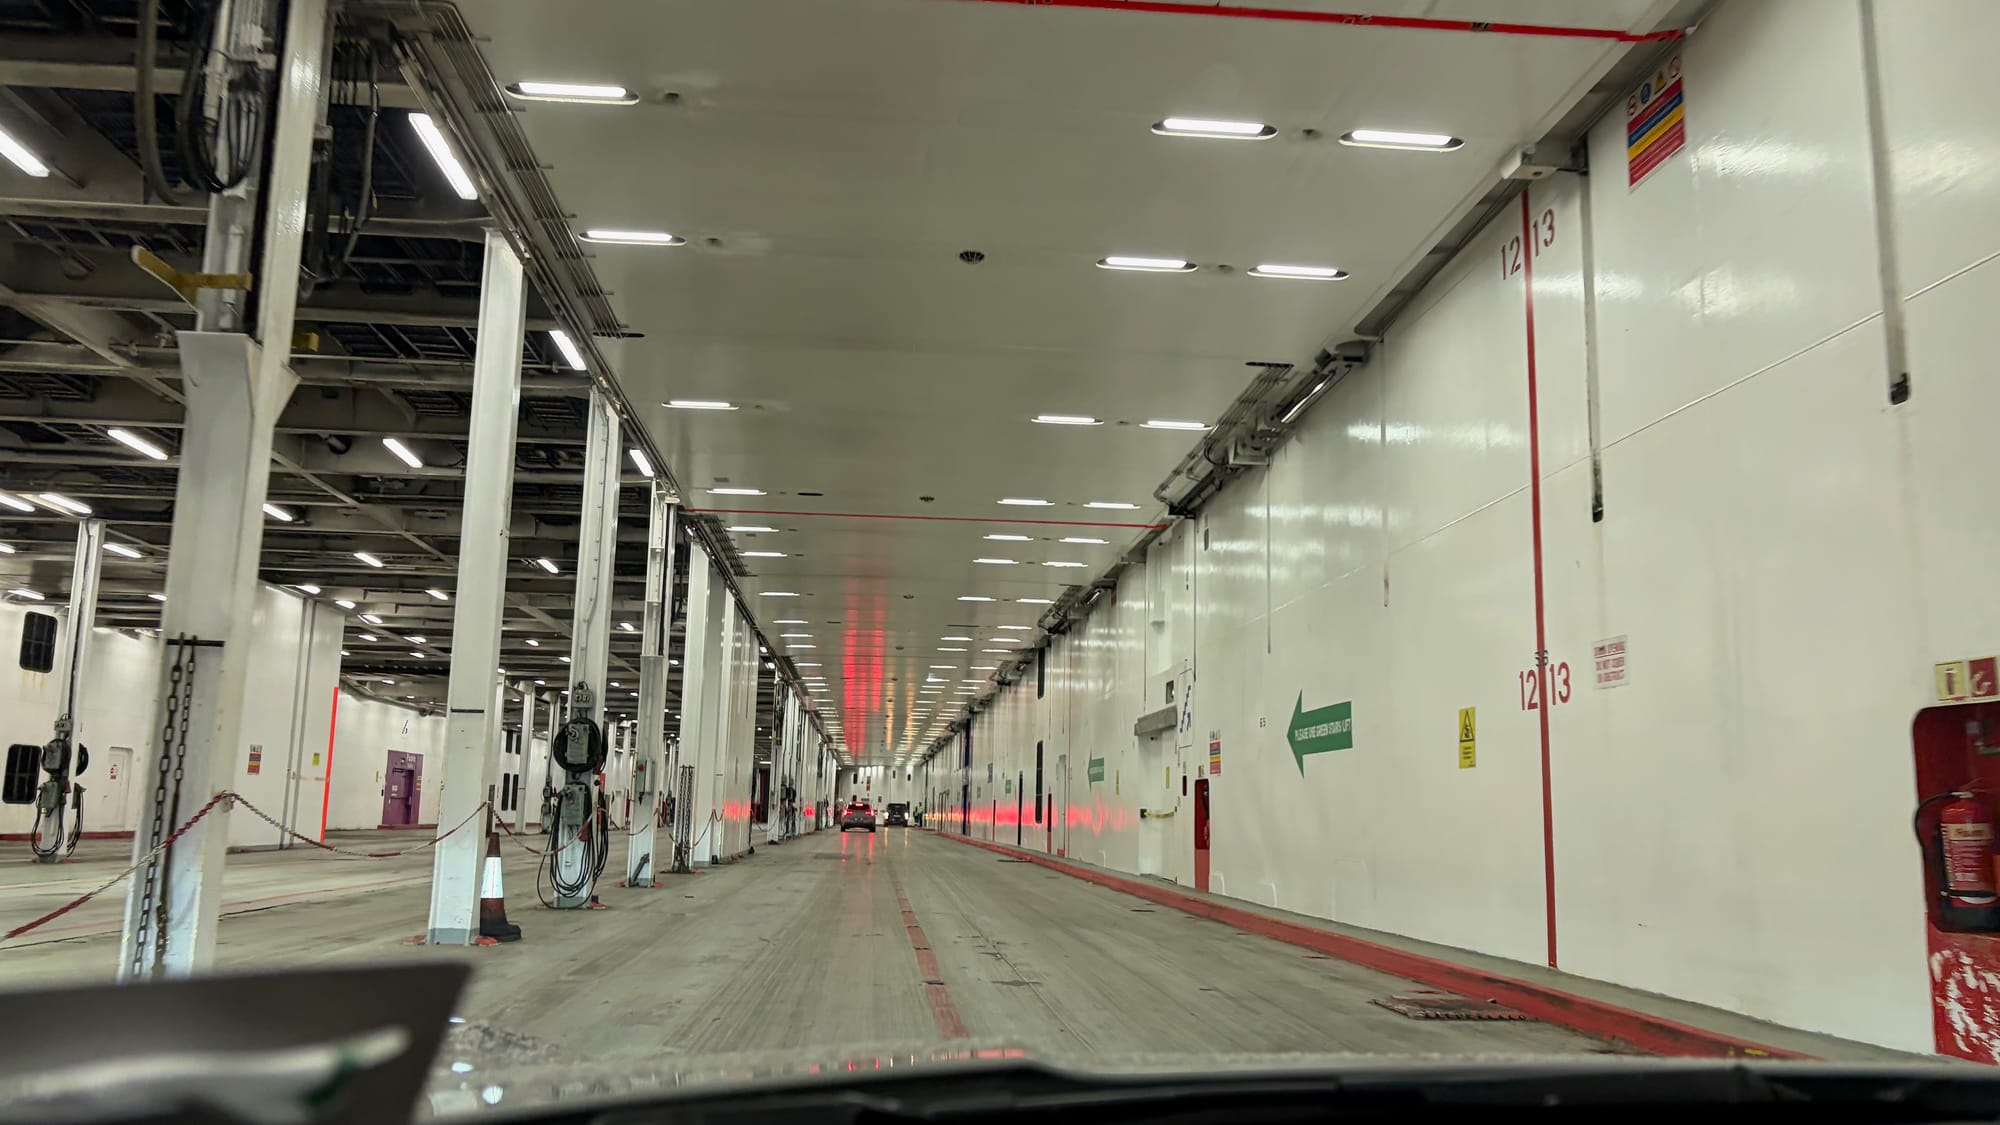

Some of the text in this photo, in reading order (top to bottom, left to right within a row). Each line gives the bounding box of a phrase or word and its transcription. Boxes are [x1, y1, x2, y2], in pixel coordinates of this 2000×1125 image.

[1532, 208, 1555, 257] 13
[1500, 235, 1521, 280] 12
[1519, 669, 1539, 711] 12
[1549, 661, 1571, 706] 13
